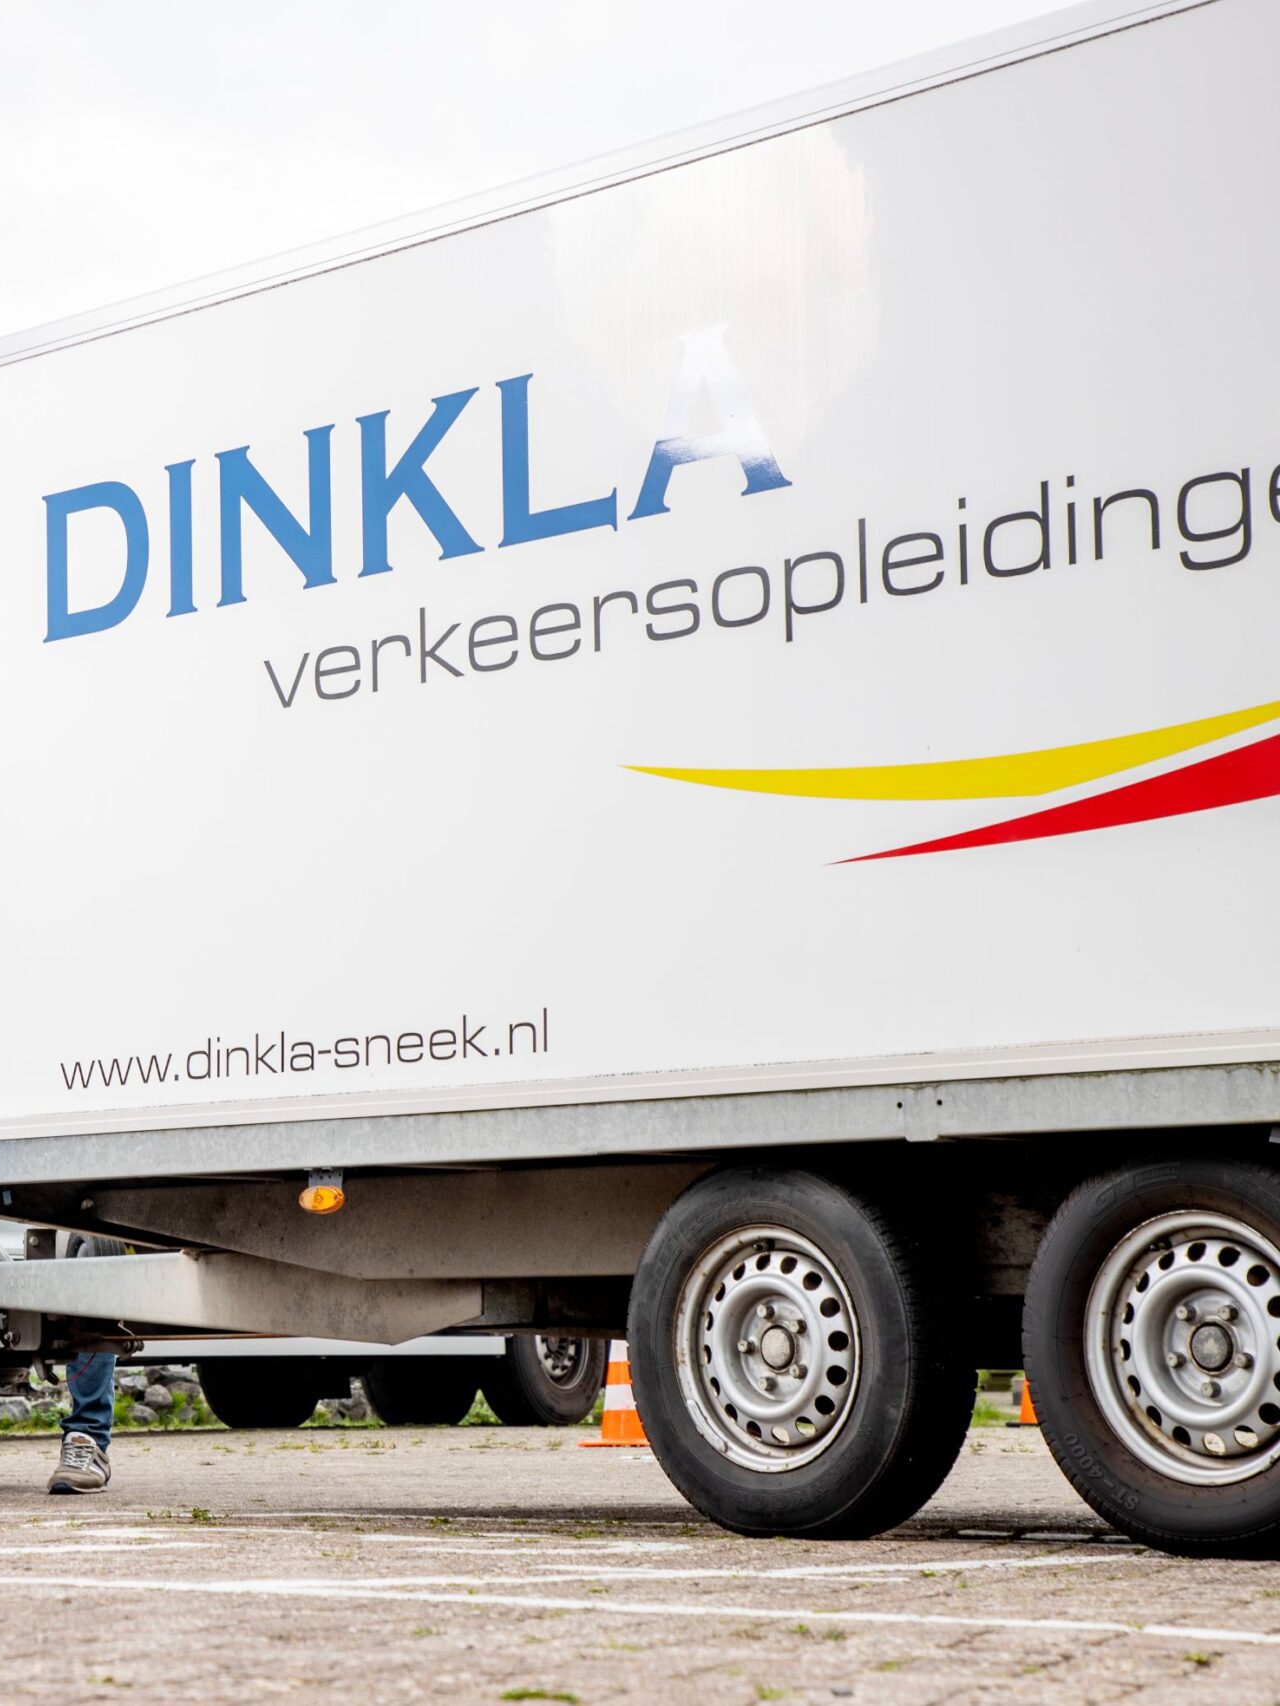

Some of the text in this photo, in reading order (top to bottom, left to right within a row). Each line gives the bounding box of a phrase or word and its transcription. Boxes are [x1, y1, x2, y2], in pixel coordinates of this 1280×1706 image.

[42, 324, 793, 643] DINKLA
[263, 463, 1280, 708] verkeersopleiding
[60, 1007, 548, 1091] www.dinkla-sneek.nl
[1063, 1432, 1140, 1511] ST-4000
